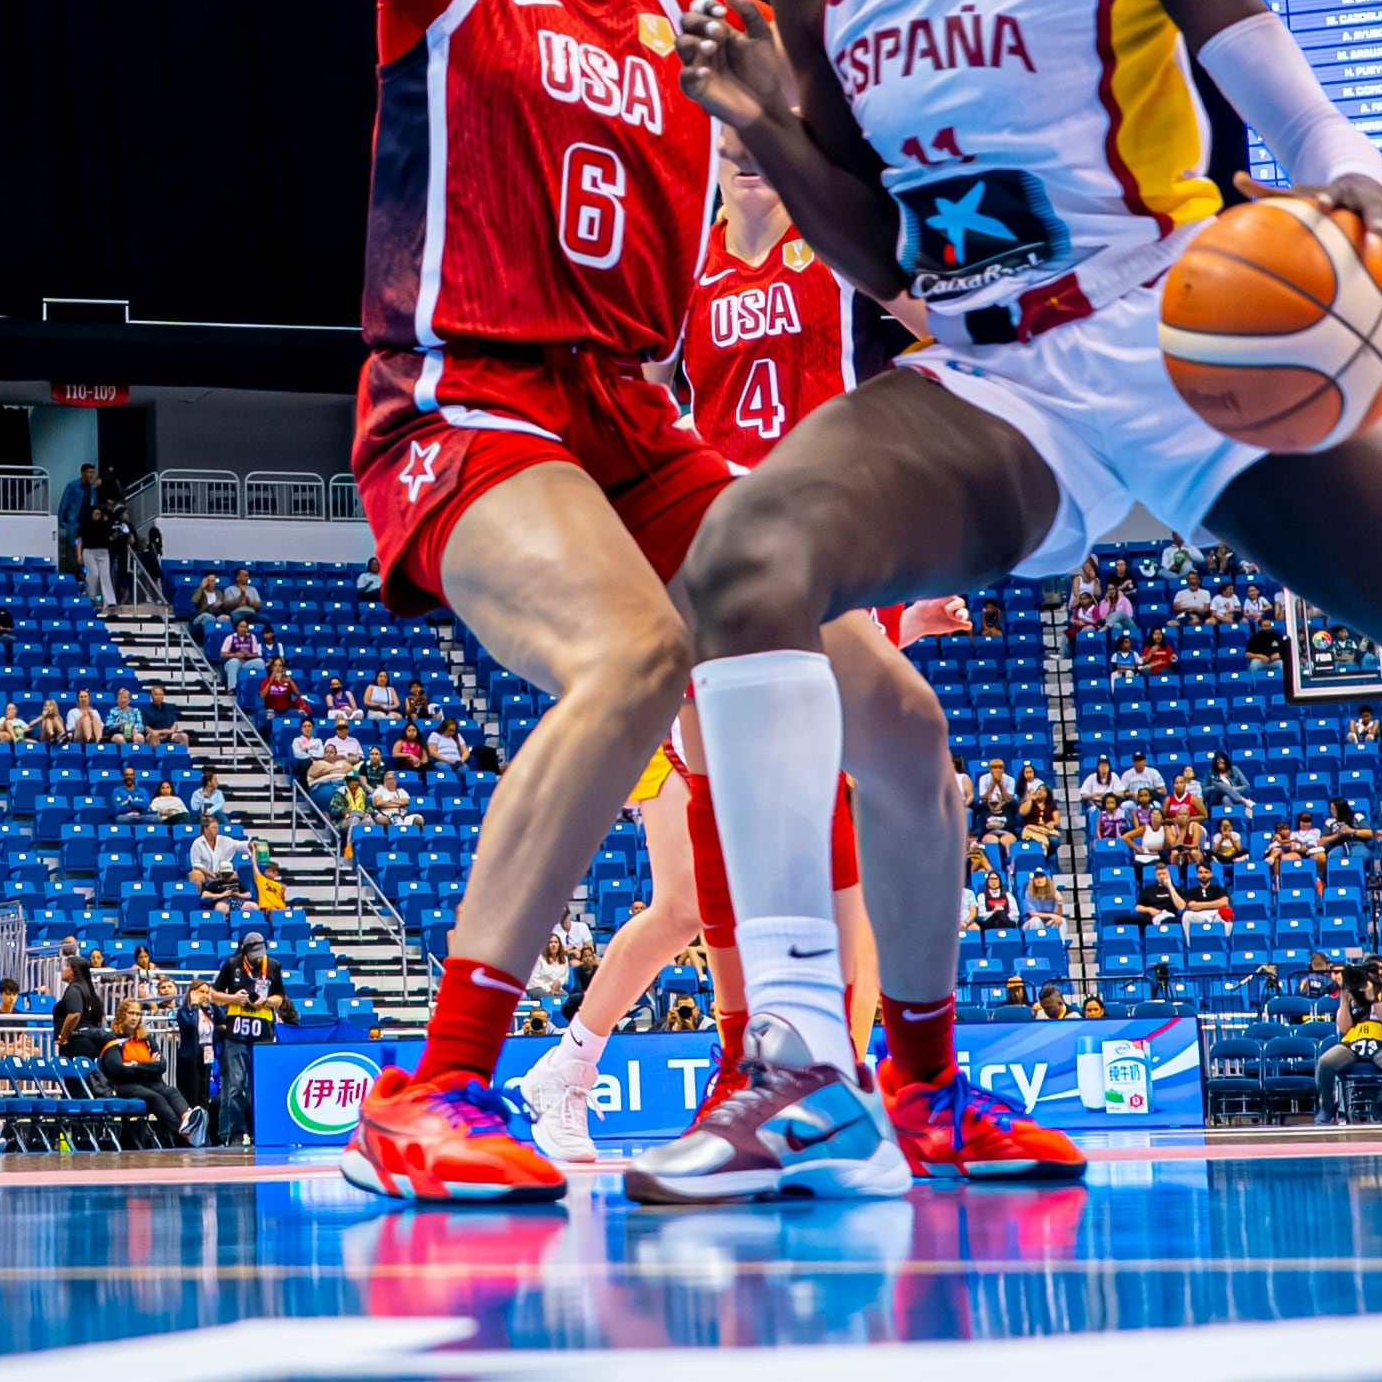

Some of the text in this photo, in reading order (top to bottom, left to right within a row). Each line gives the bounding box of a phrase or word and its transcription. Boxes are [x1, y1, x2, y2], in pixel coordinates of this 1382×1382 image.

[538, 29, 664, 136] USA
[559, 142, 626, 270] 6
[711, 282, 802, 348] USA
[65, 384, 117, 401] 110-109
[736, 358, 786, 440] 4
[233, 1016, 262, 1037] 050
